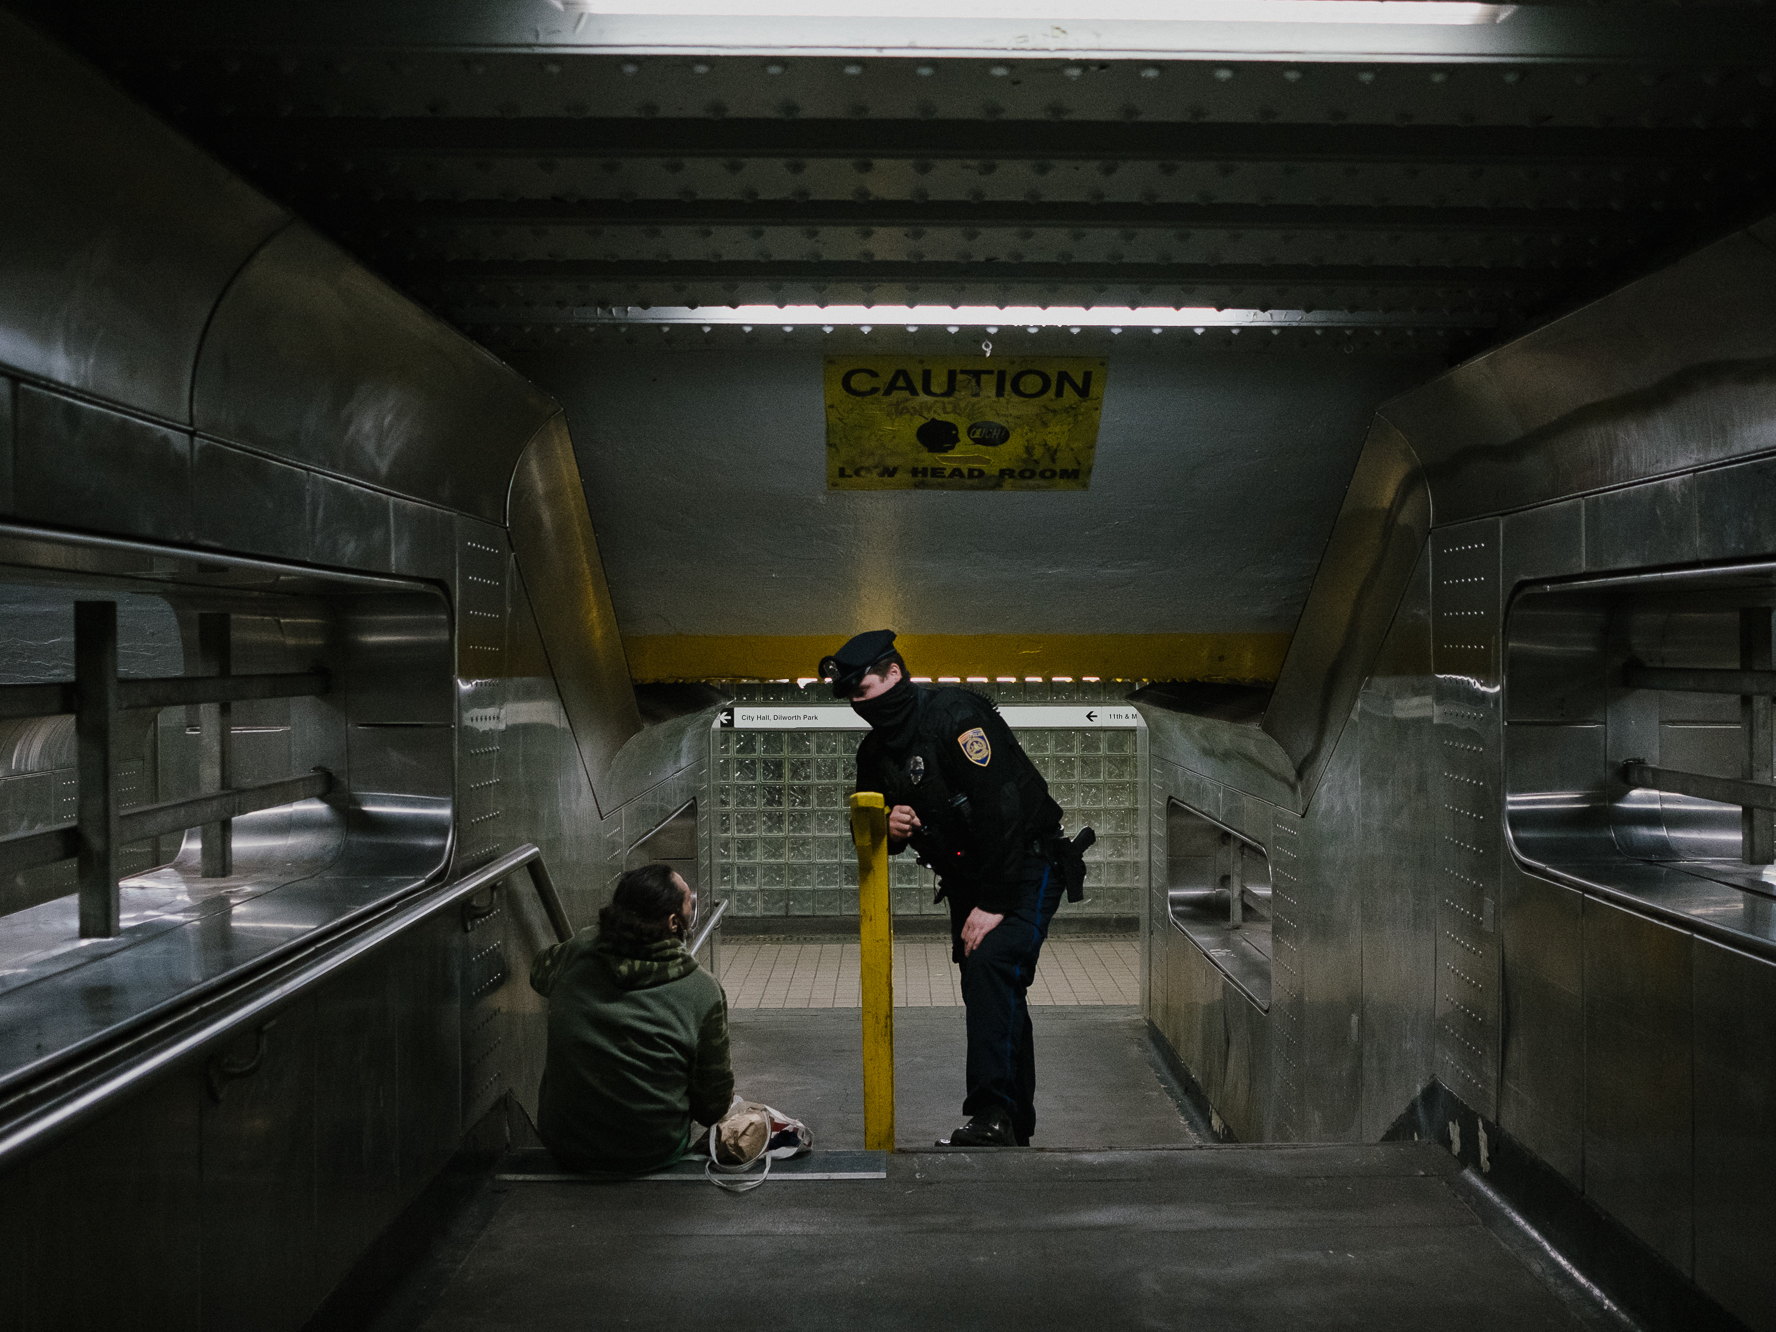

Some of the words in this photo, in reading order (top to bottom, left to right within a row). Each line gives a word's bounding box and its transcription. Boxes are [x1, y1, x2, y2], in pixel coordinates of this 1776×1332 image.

[841, 368, 1093, 398] CAUTION
[838, 466, 899, 479] LOW
[911, 466, 986, 479] HEAD
[998, 467, 1081, 480] ROOM
